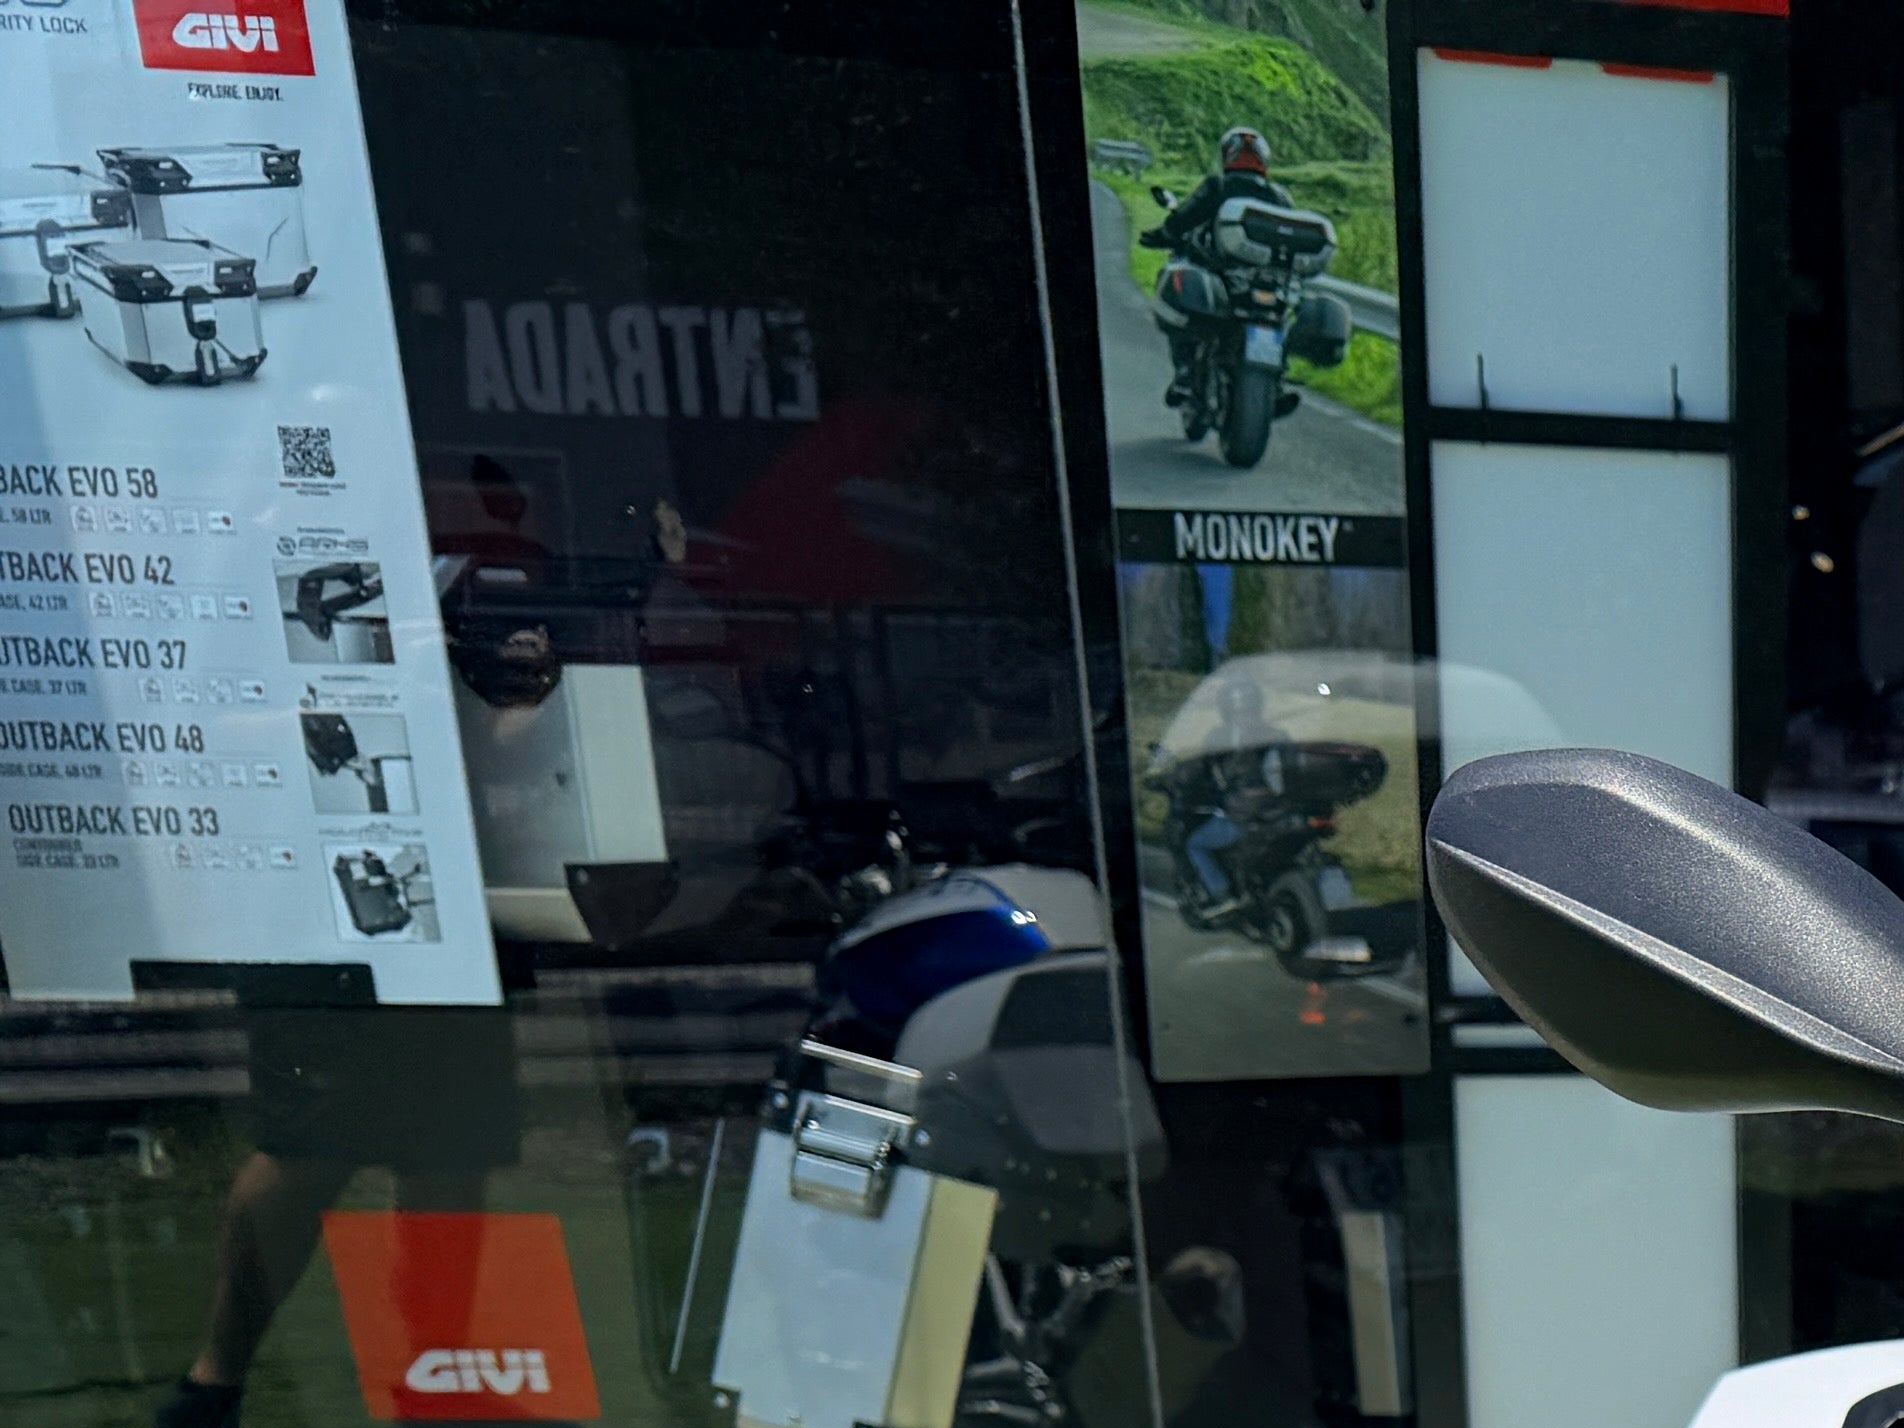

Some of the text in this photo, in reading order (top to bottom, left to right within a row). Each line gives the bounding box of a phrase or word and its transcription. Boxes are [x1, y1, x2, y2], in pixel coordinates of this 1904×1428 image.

[40, 16, 88, 34] LOCK
[172, 12, 280, 53] GIVI
[67, 466, 119, 498] EVO
[125, 467, 159, 499] 58
[1173, 511, 1339, 563] MONOKEY
[84, 552, 136, 585] EVO
[143, 555, 176, 586] 42
[100, 638, 151, 669] EVO
[157, 639, 187, 670] 37
[116, 722, 167, 753] EVO
[174, 723, 205, 754] 48
[8, 803, 221, 837] OUTBACK EVO 33
[404, 1348, 553, 1396] GIVI
